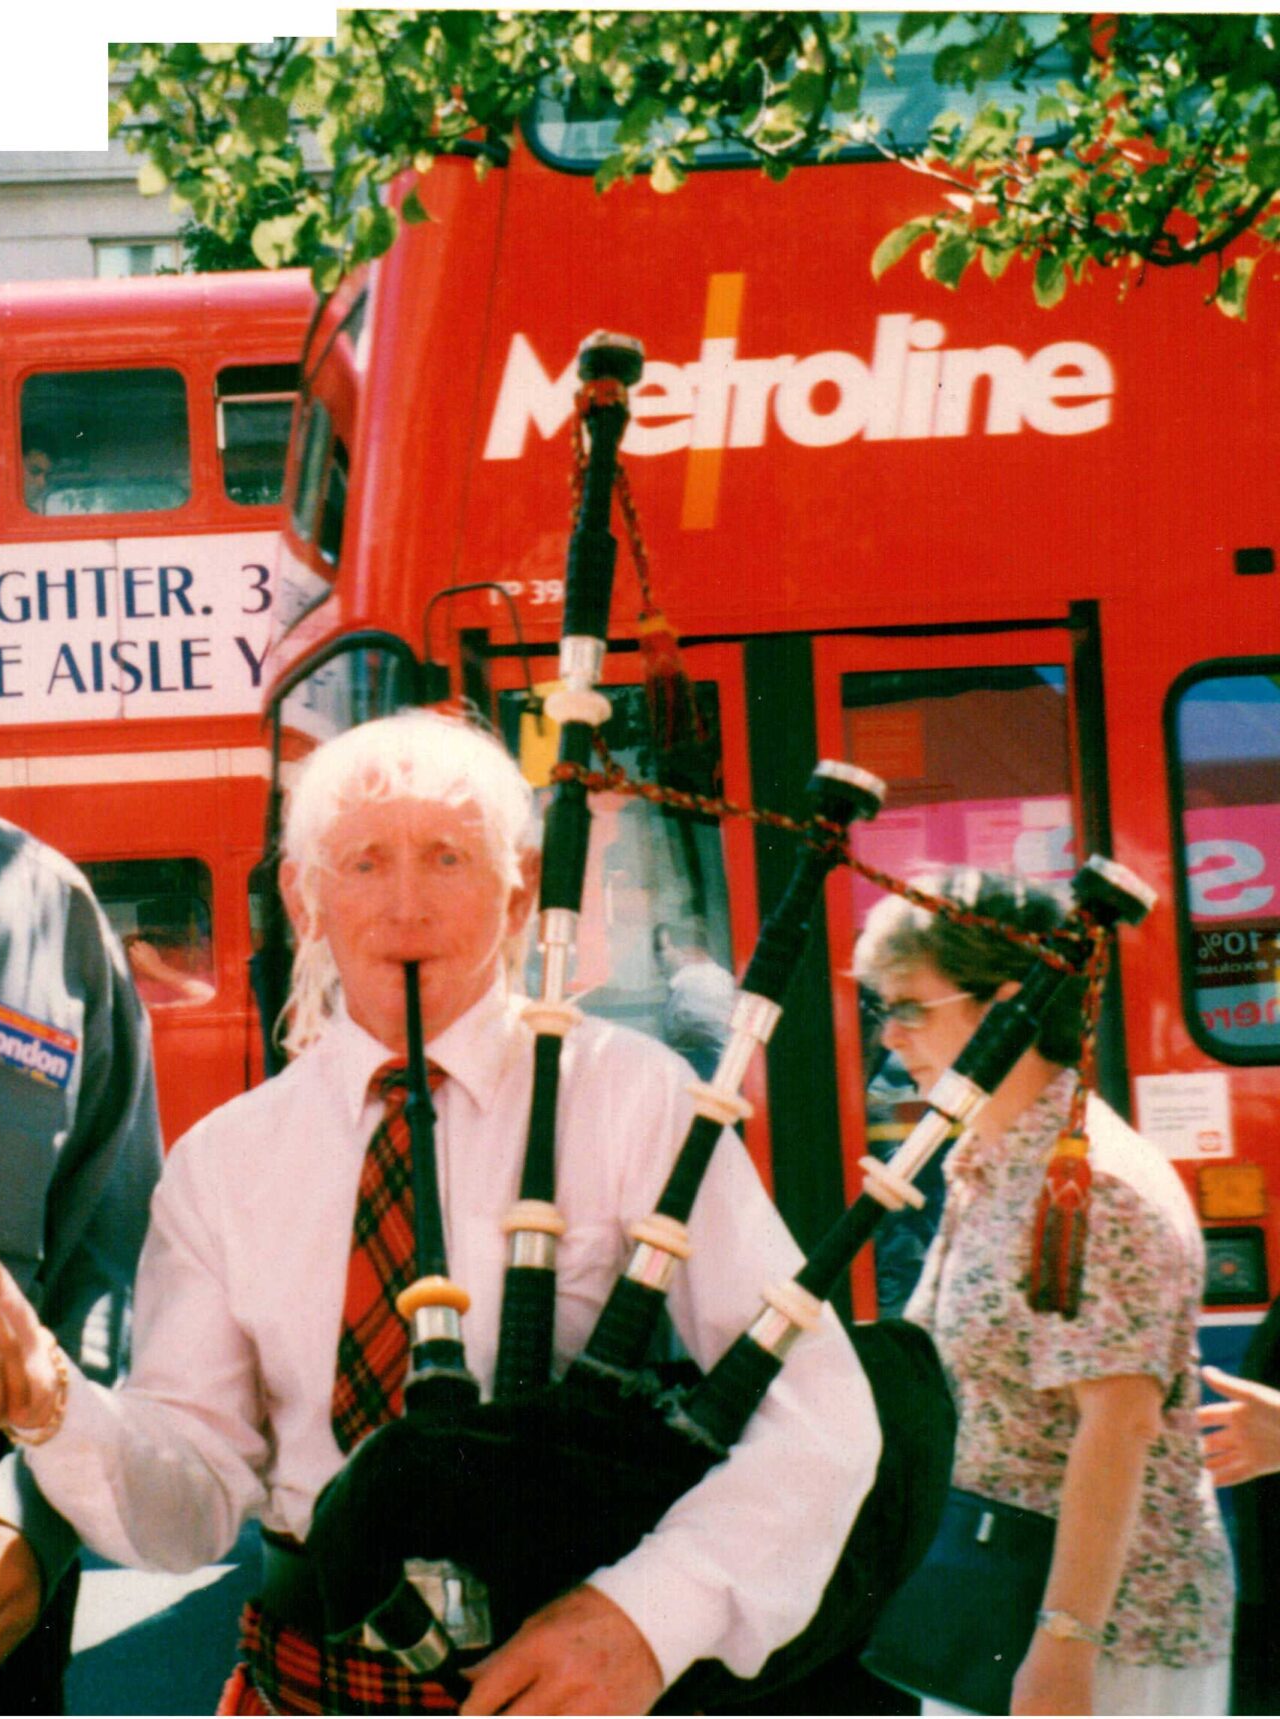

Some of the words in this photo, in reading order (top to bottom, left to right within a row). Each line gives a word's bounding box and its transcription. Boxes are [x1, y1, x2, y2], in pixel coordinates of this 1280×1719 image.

[483, 313, 1114, 460] Metroline
[240, 563, 273, 614] 3
[46, 637, 213, 696] AISLE
